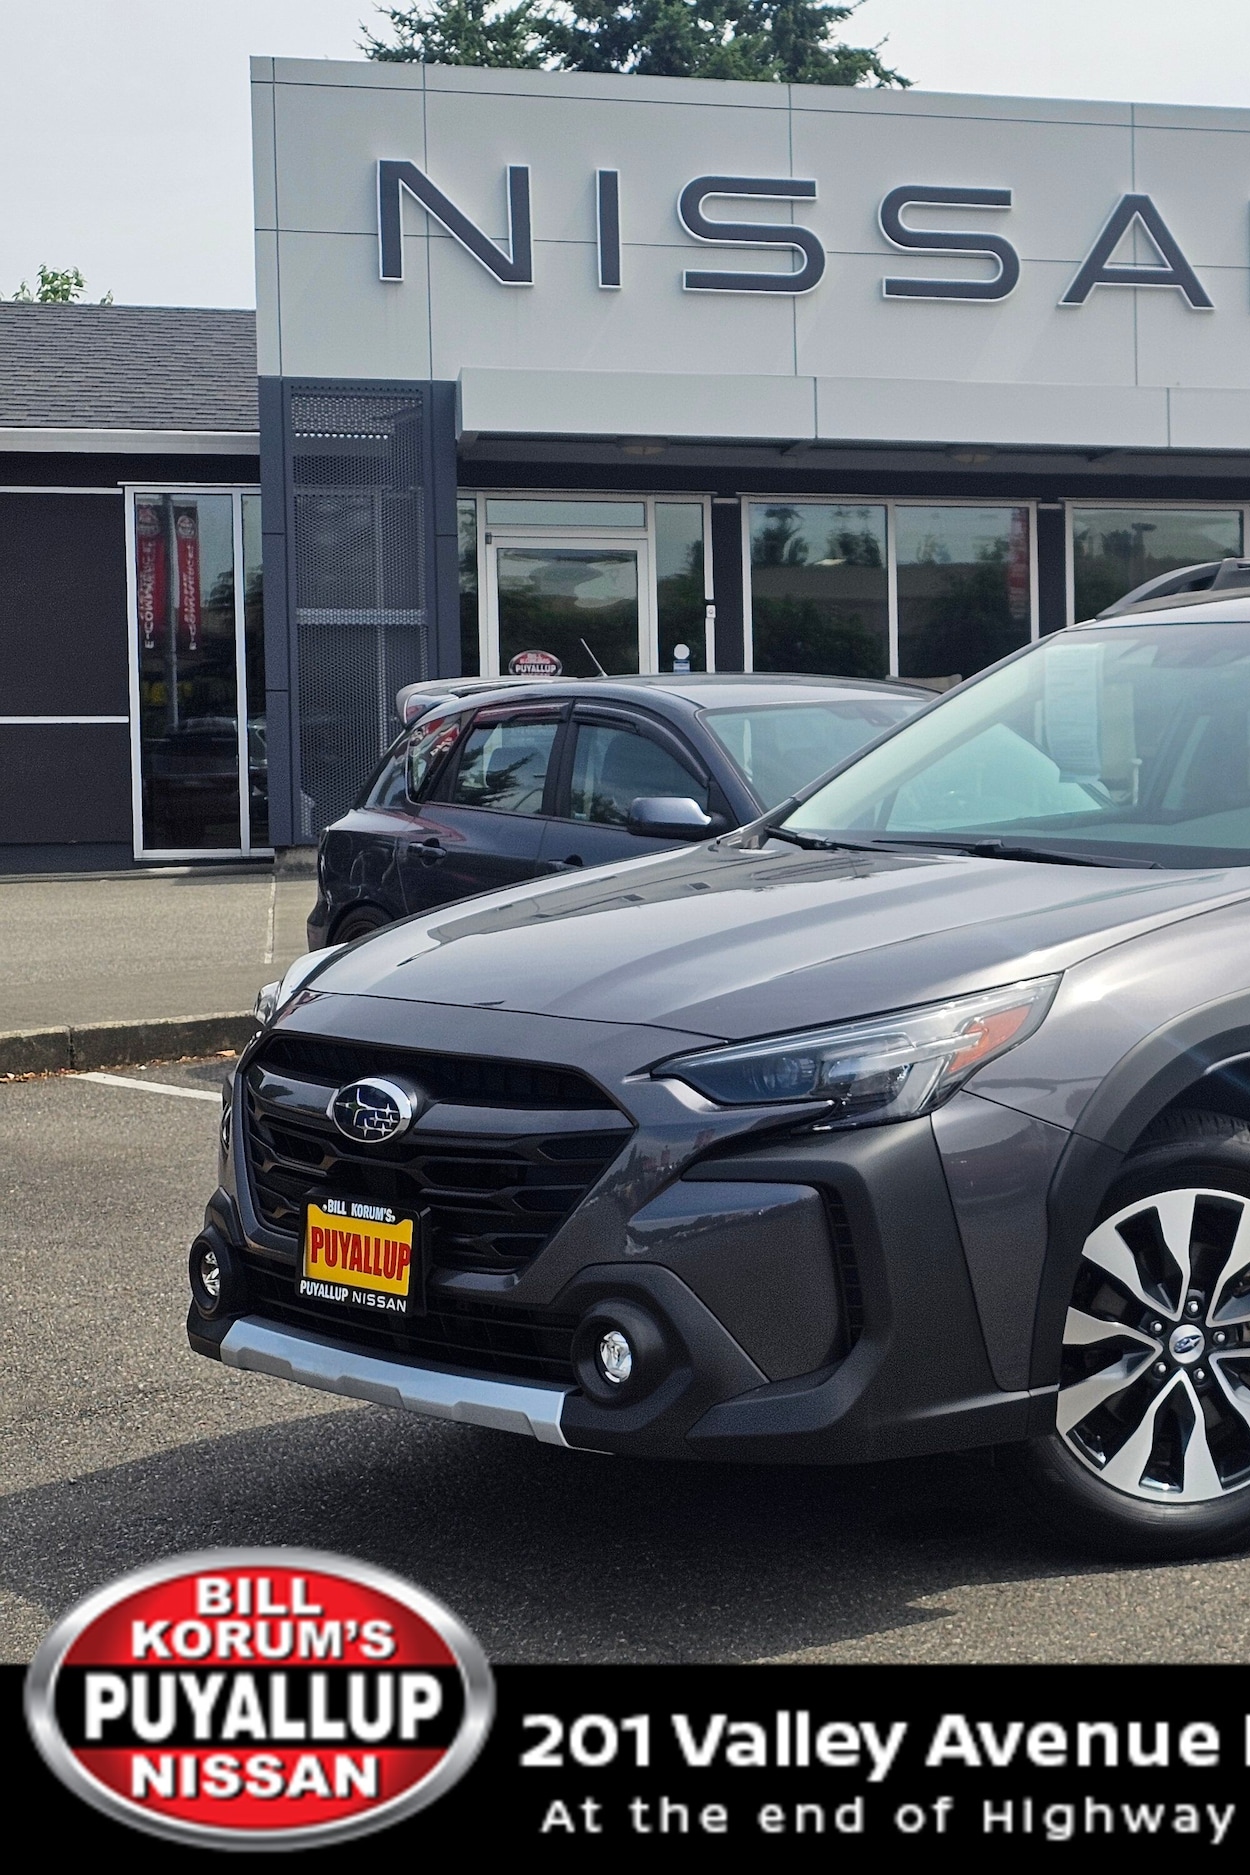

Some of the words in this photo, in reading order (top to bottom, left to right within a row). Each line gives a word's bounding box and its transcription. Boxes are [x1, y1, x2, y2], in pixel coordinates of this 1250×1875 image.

[515, 664, 557, 673] PUYALLUP
[327, 1199, 347, 1215] BILL
[351, 1202, 393, 1223] KORUM'S
[311, 1225, 411, 1282] PUYALLUP
[300, 1280, 349, 1302] PUYALLUP
[352, 1291, 407, 1313] NISSAN
